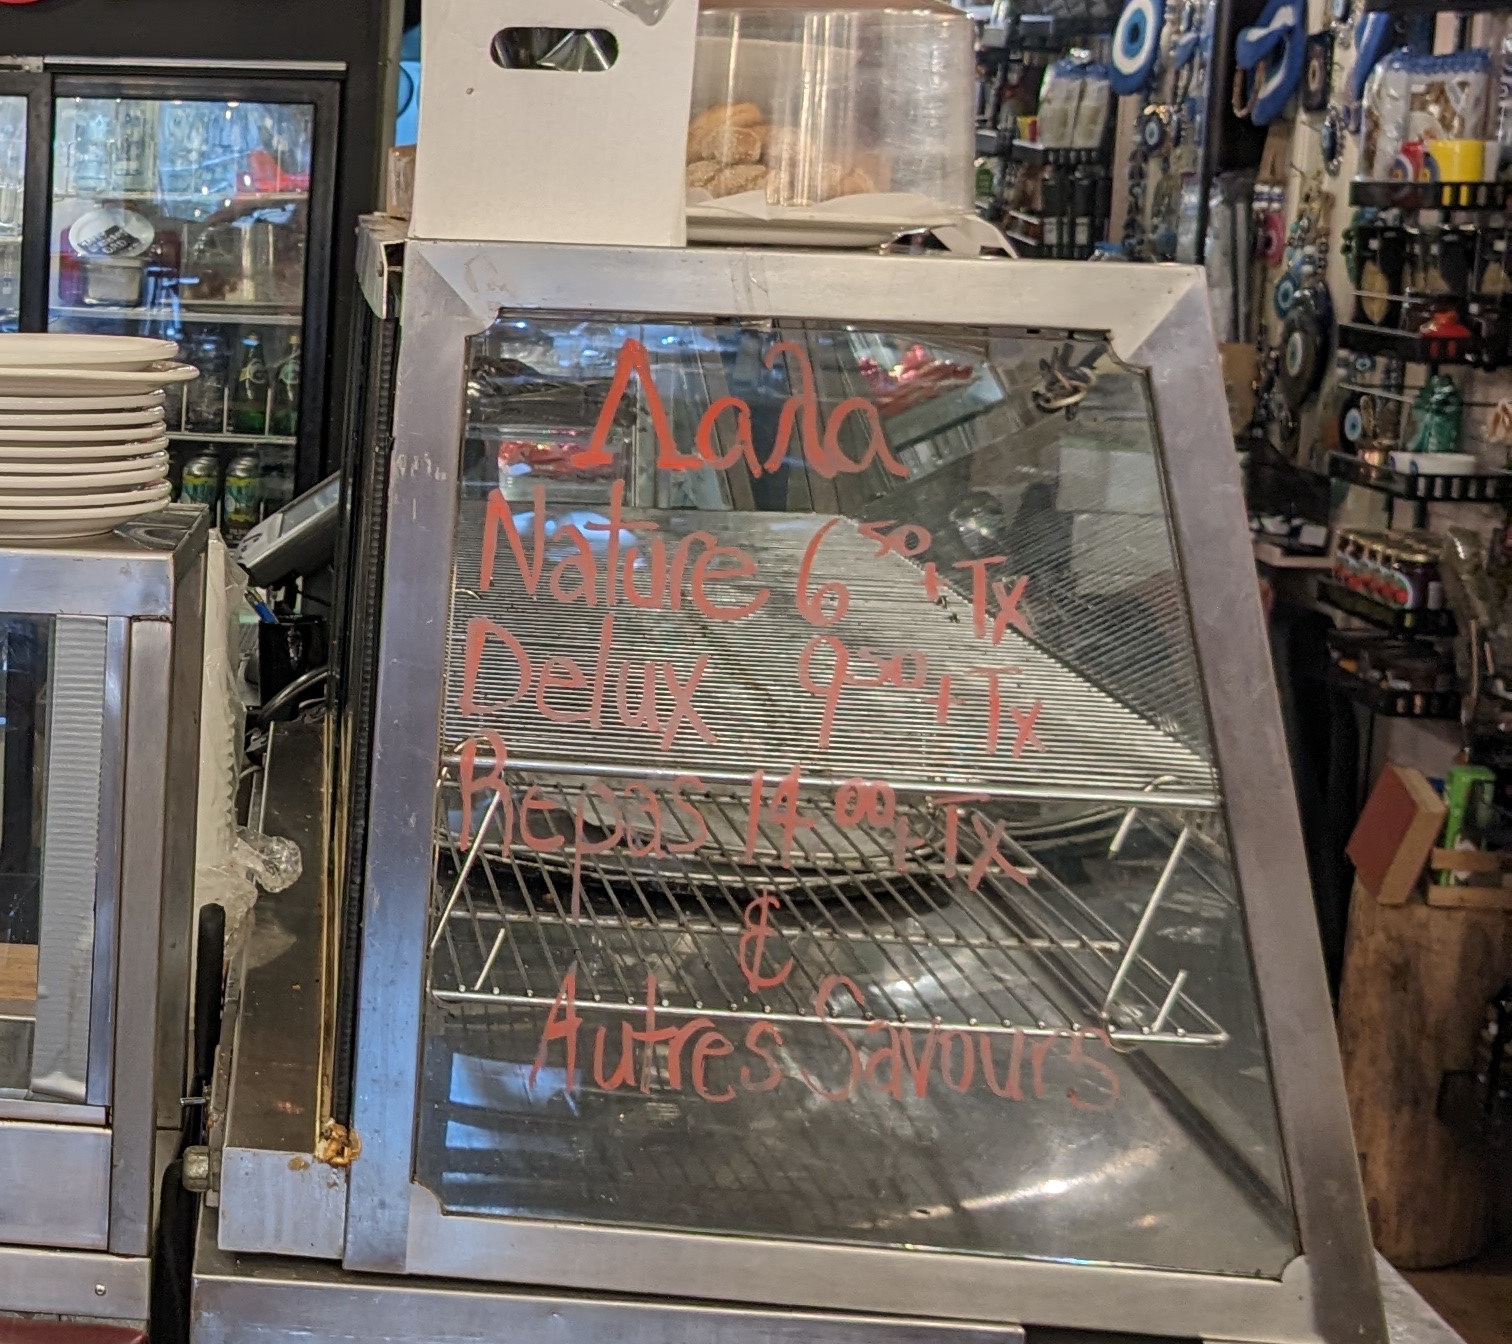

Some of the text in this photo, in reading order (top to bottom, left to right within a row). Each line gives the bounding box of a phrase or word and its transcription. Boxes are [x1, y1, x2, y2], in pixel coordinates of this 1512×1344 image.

[478, 477, 771, 622] Nature
[458, 612, 718, 752] Delux
[458, 729, 707, 925] Repas
[528, 964, 1122, 1112] Autres Savours
